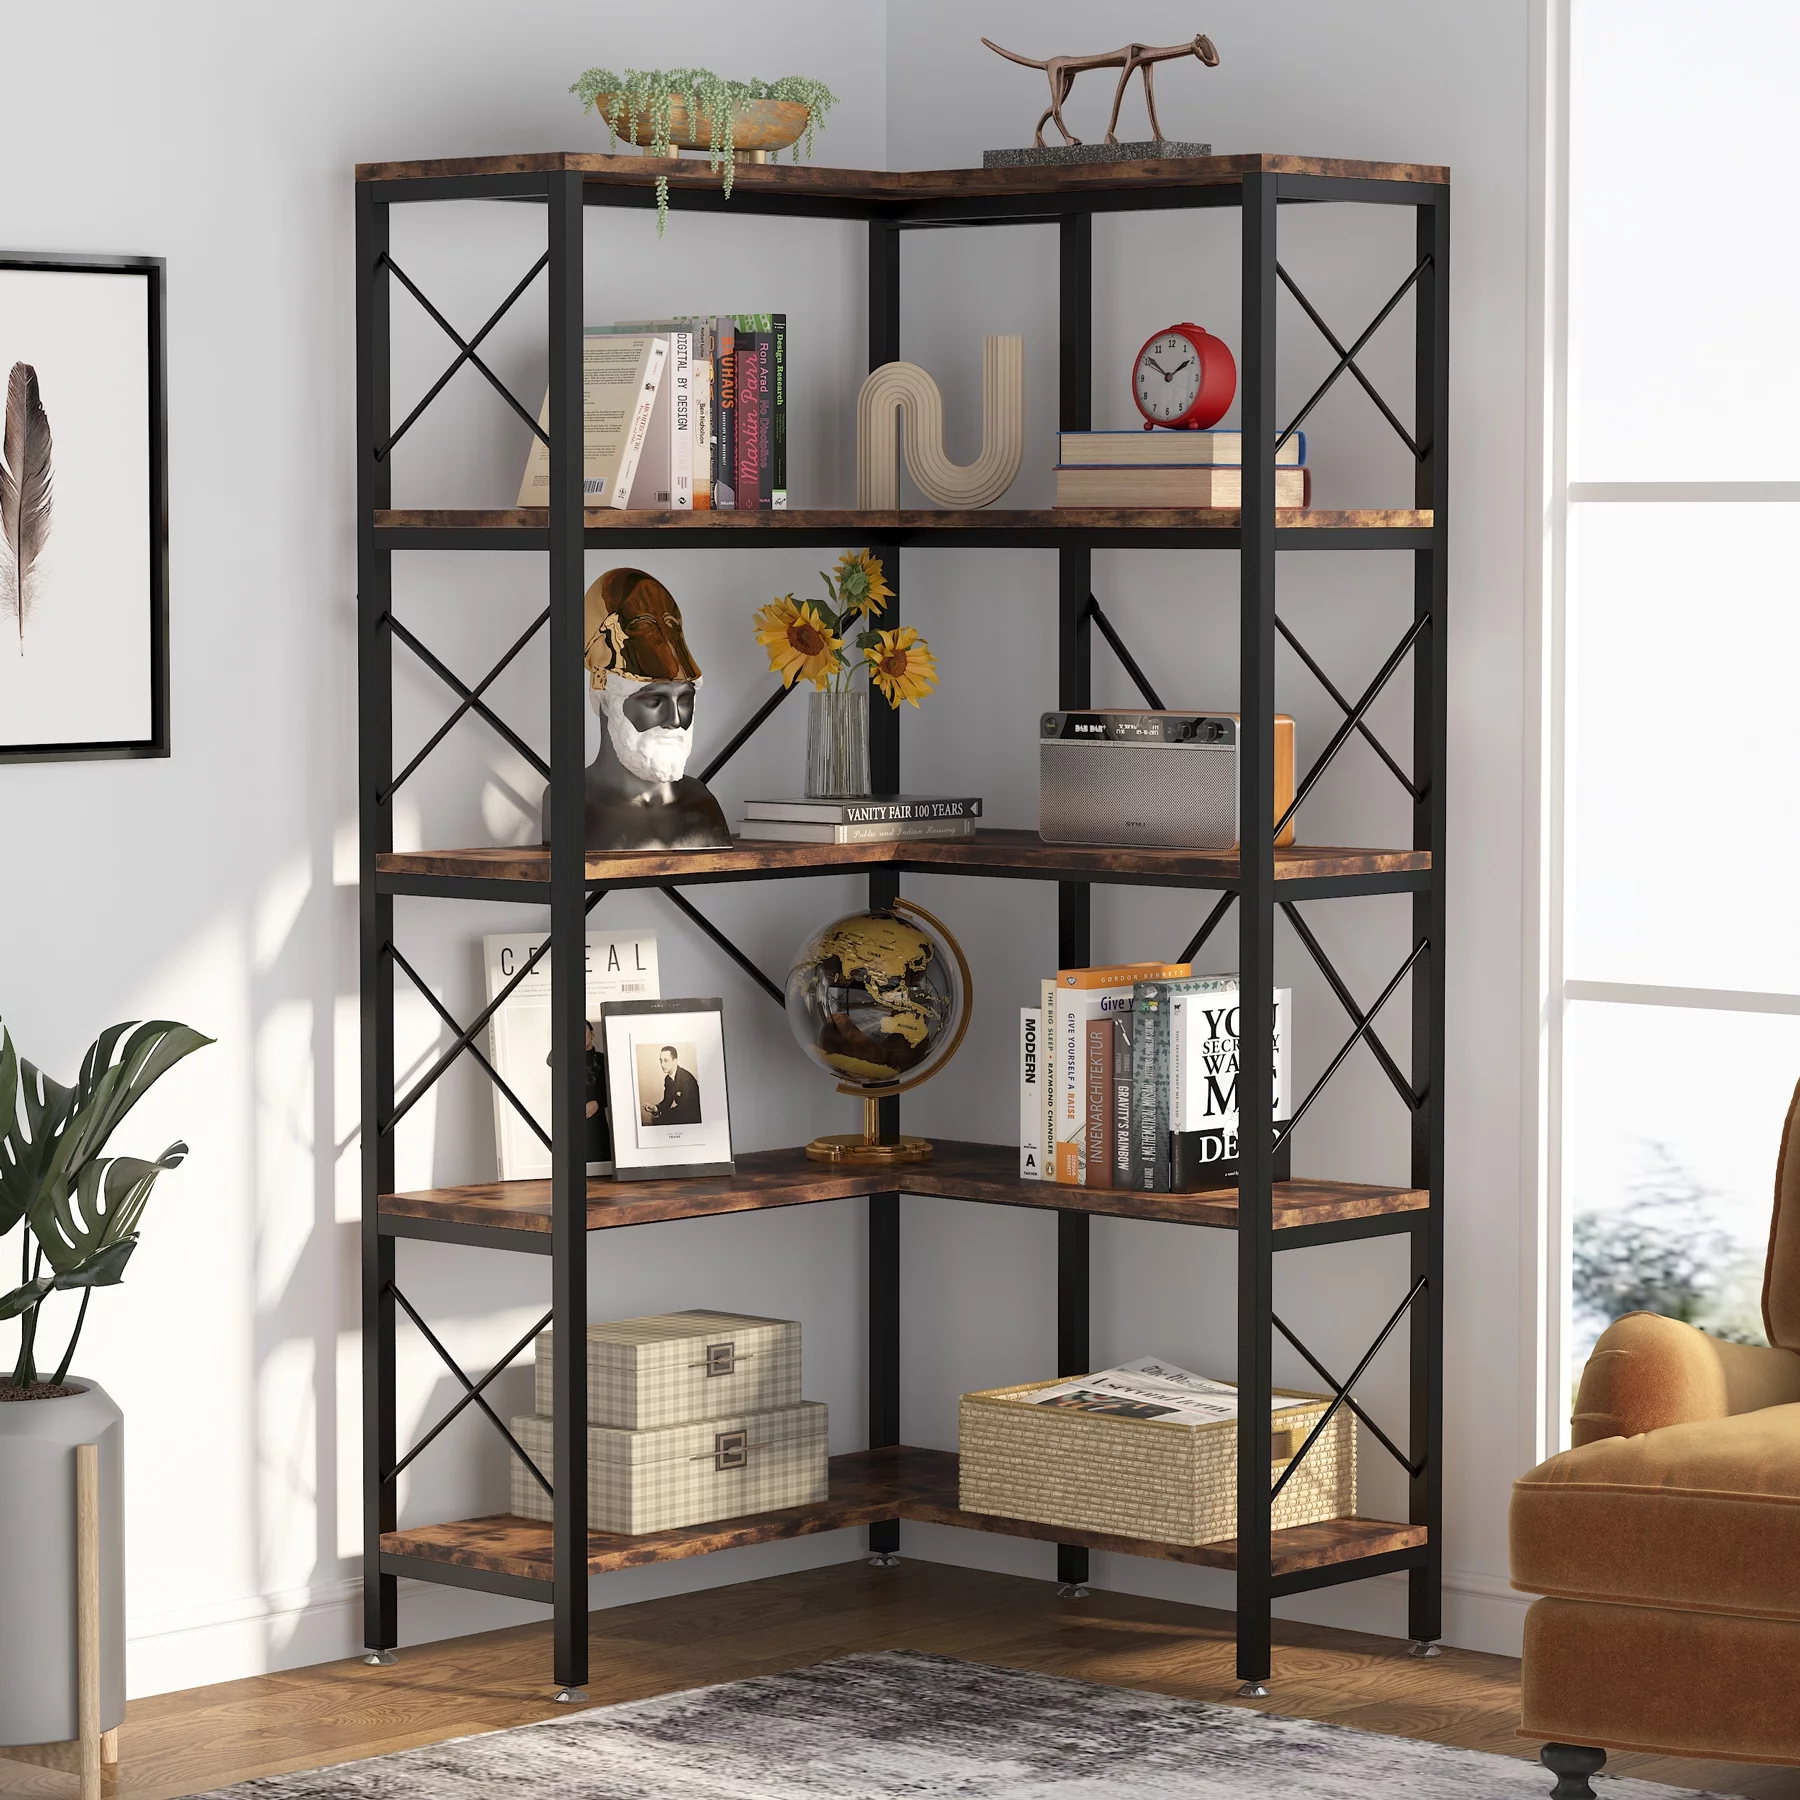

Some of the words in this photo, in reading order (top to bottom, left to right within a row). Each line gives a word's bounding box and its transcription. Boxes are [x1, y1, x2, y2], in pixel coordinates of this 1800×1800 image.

[677, 333, 687, 371] DIGITAL
[775, 333, 784, 363] Design
[1155, 345, 1162, 353] 11
[1168, 339, 1176, 348] 12
[1183, 345, 1187, 353] 1
[760, 343, 769, 364] Ron
[1144, 358, 1151, 366] 10
[1190, 356, 1195, 364] 2
[721, 336, 734, 409] BAUHAUS
[740, 353, 758, 404] Parr
[760, 367, 769, 392] Arad
[1140, 374, 1145, 382] 9
[1194, 374, 1199, 382] 3
[677, 377, 687, 389] BY
[776, 365, 784, 406] Research
[1143, 392, 1148, 400] 8
[677, 395, 687, 431] DESIGN
[760, 399, 769, 415] No
[1153, 404, 1157, 412] 7
[1165, 407, 1170, 415] 6
[1179, 403, 1183, 411] 5
[633, 402, 650, 452] ARCHITECTURE
[740, 409, 758, 481] Martin
[759, 418, 769, 468] Discipline
[1075, 724, 1088, 733] DAB
[847, 806, 887, 821] VANITY
[889, 805, 912, 819] FAIR
[914, 804, 930, 818] 100
[931, 802, 963, 817] YEARS
[853, 828, 877, 839] Public
[879, 828, 895, 837] and
[896, 827, 923, 836] Indian
[926, 825, 956, 835] Housing
[501, 943, 647, 976] CEEAL
[1101, 974, 1138, 983] GORDON
[1144, 970, 1184, 979] BENNETT
[1100, 996, 1124, 1011] Give
[897, 1022, 918, 1031] AUSTRALIA
[1025, 1018, 1035, 1083] MODERN
[1090, 1031, 1103, 1164] INNENARCHITEKTUR
[1142, 1082, 1156, 1107] MOSAIC
[1118, 1085, 1130, 1128] GRAVITY'S
[1142, 1109, 1156, 1156] MATHEMATICAL
[1118, 1130, 1130, 1171] RAINBOW
[1026, 1153, 1035, 1167] A
